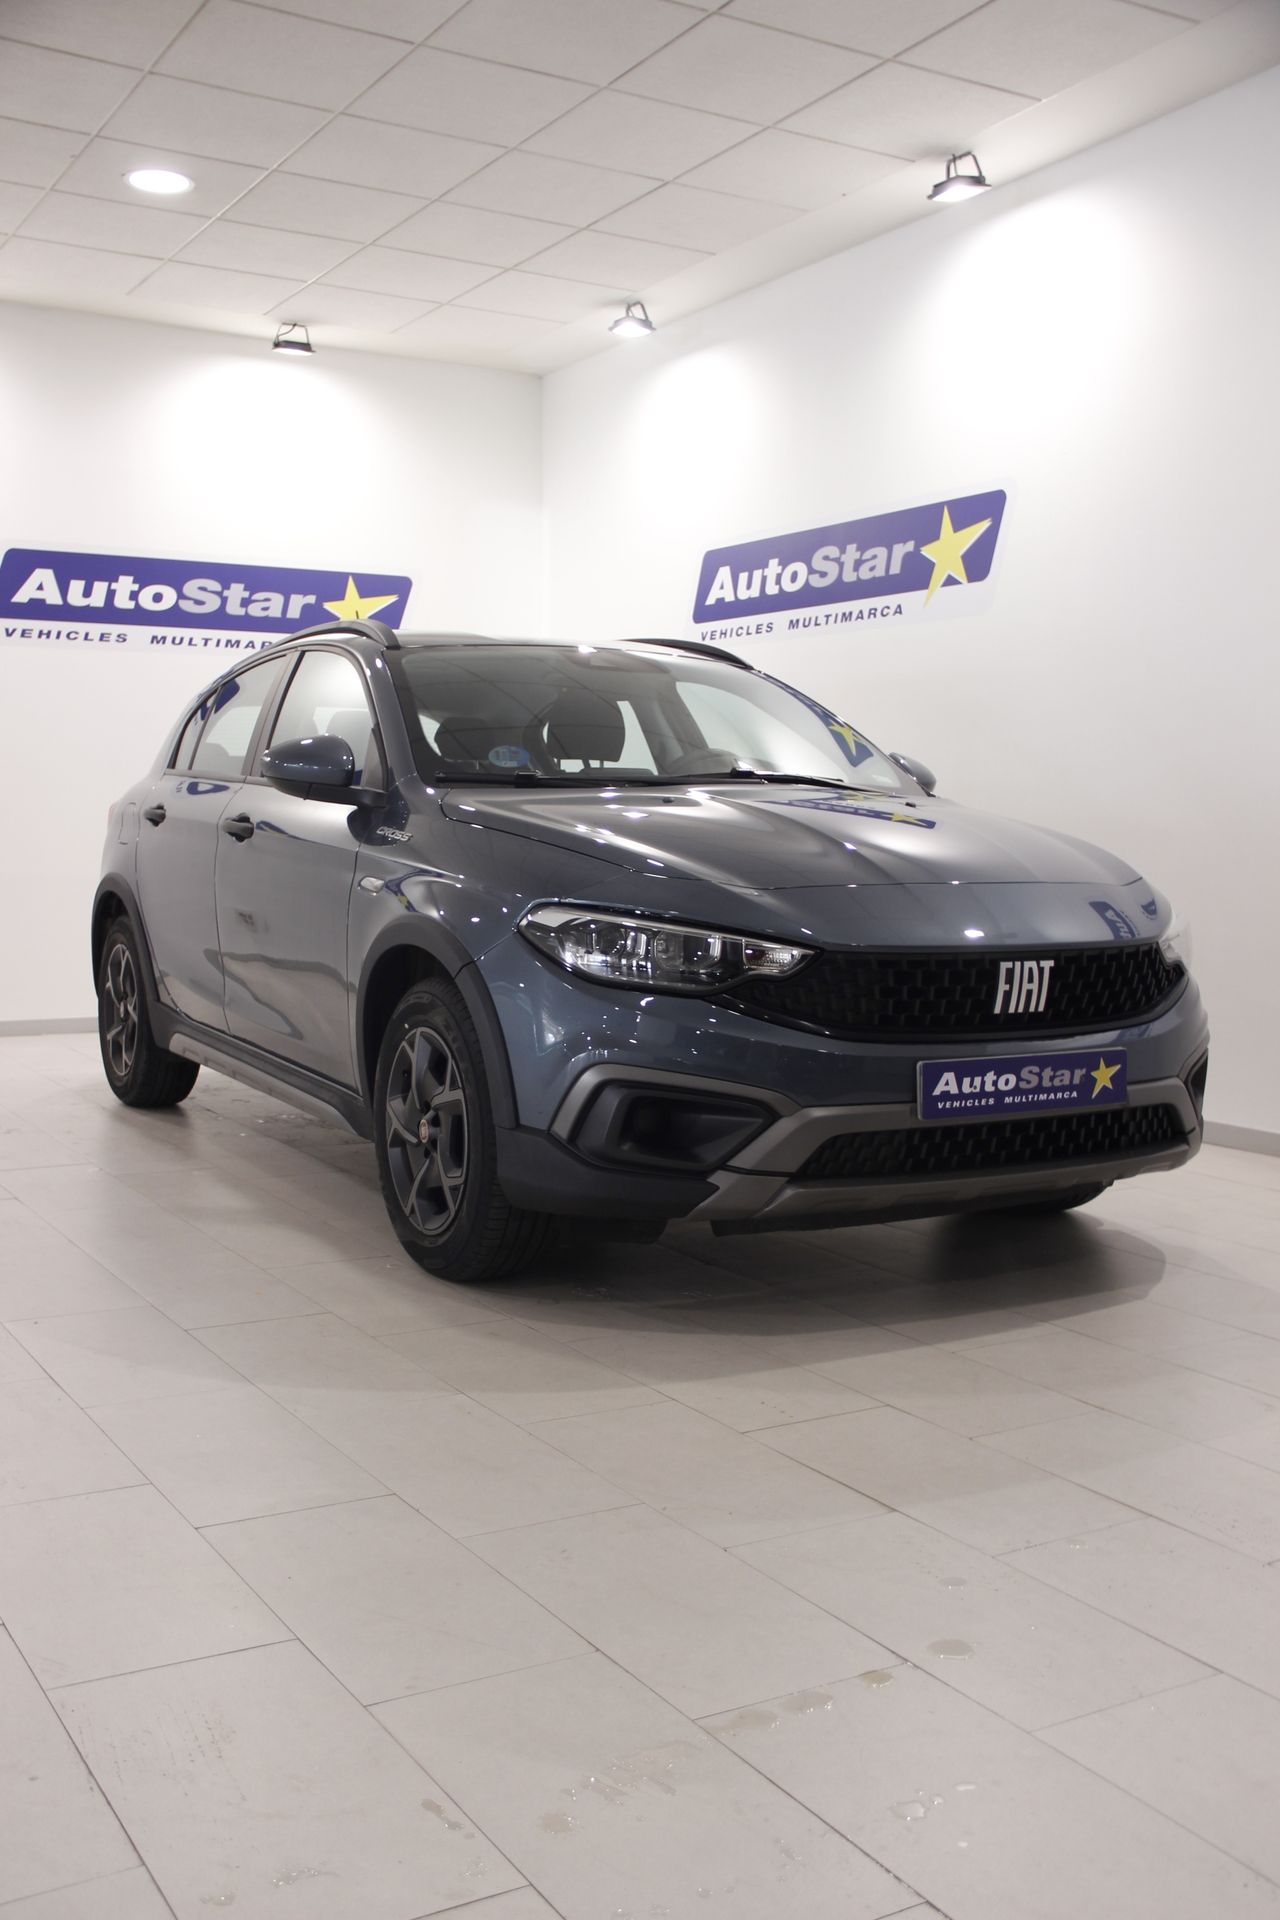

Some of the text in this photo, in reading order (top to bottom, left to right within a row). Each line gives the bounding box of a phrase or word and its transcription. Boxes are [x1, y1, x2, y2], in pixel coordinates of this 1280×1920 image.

[704, 540, 915, 606] AutoStar
[11, 567, 316, 619] AutoStar
[4, 627, 273, 650] VEHICLES MULTIMAR
[700, 604, 903, 642] VEHICLES MULTIMARCA
[376, 826, 413, 842] CROSS
[994, 960, 1054, 1014] FIAT
[932, 1065, 1087, 1096] AutoStar
[937, 1091, 1078, 1109] VEHICLES MULTIMARCA
